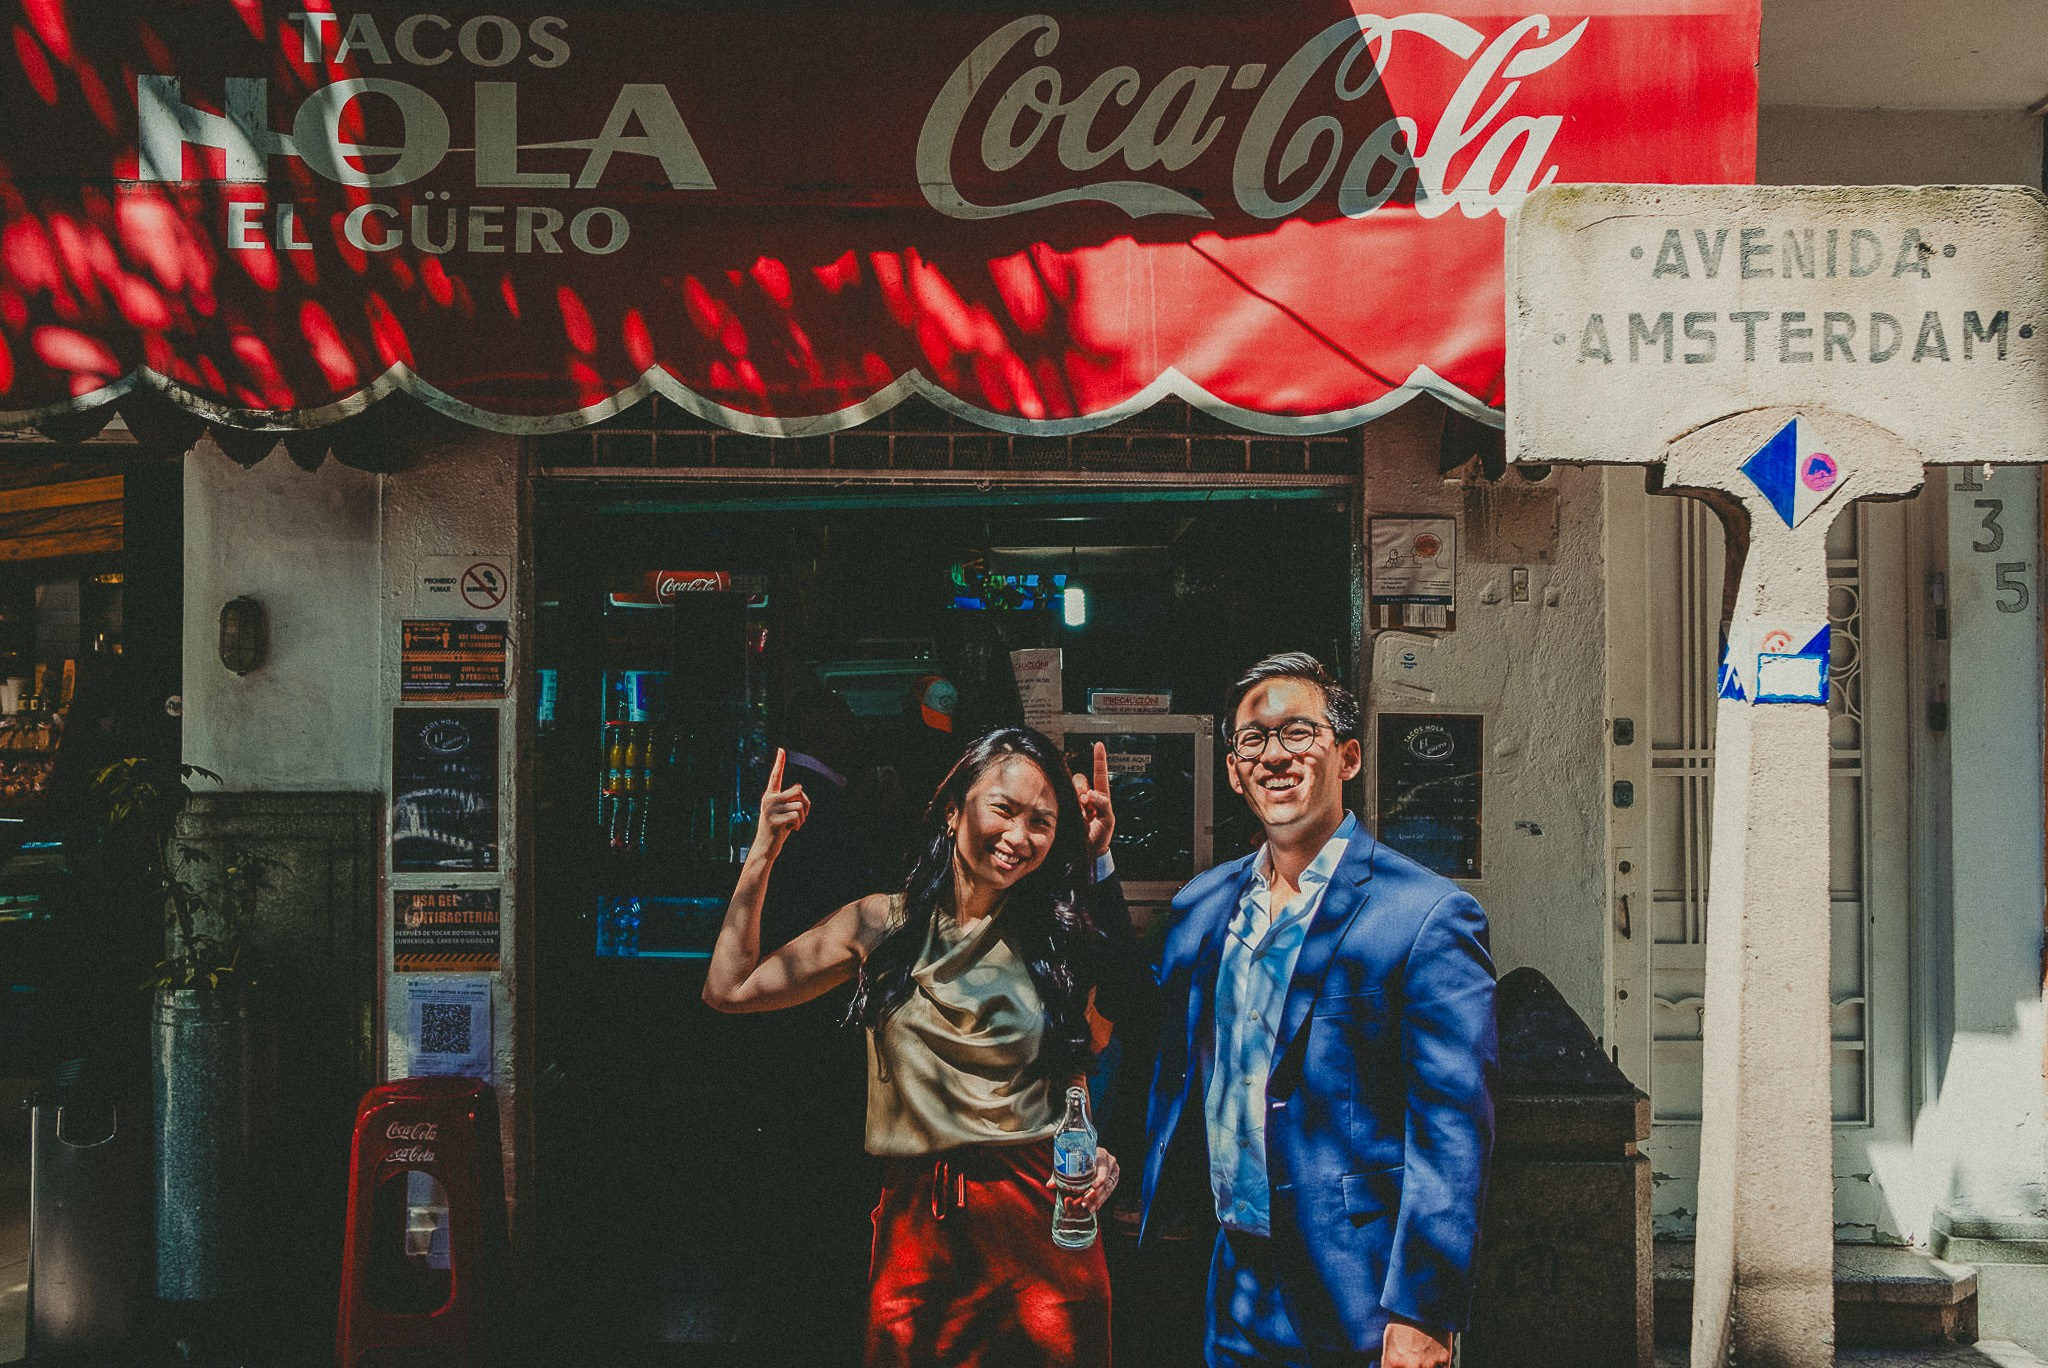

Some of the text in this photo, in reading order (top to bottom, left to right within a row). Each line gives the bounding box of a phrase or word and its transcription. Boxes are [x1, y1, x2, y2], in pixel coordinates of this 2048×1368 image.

[289, 13, 570, 67] TACOS
[138, 75, 717, 190] HOLA
[915, 13, 1589, 219] Coca-Cola
[228, 191, 631, 254] EL GÜERO
[1577, 309, 2011, 365] AMSTERDAM
[412, 894, 459, 907] USA GEL
[412, 910, 499, 924] ANTIBACTERIAL
